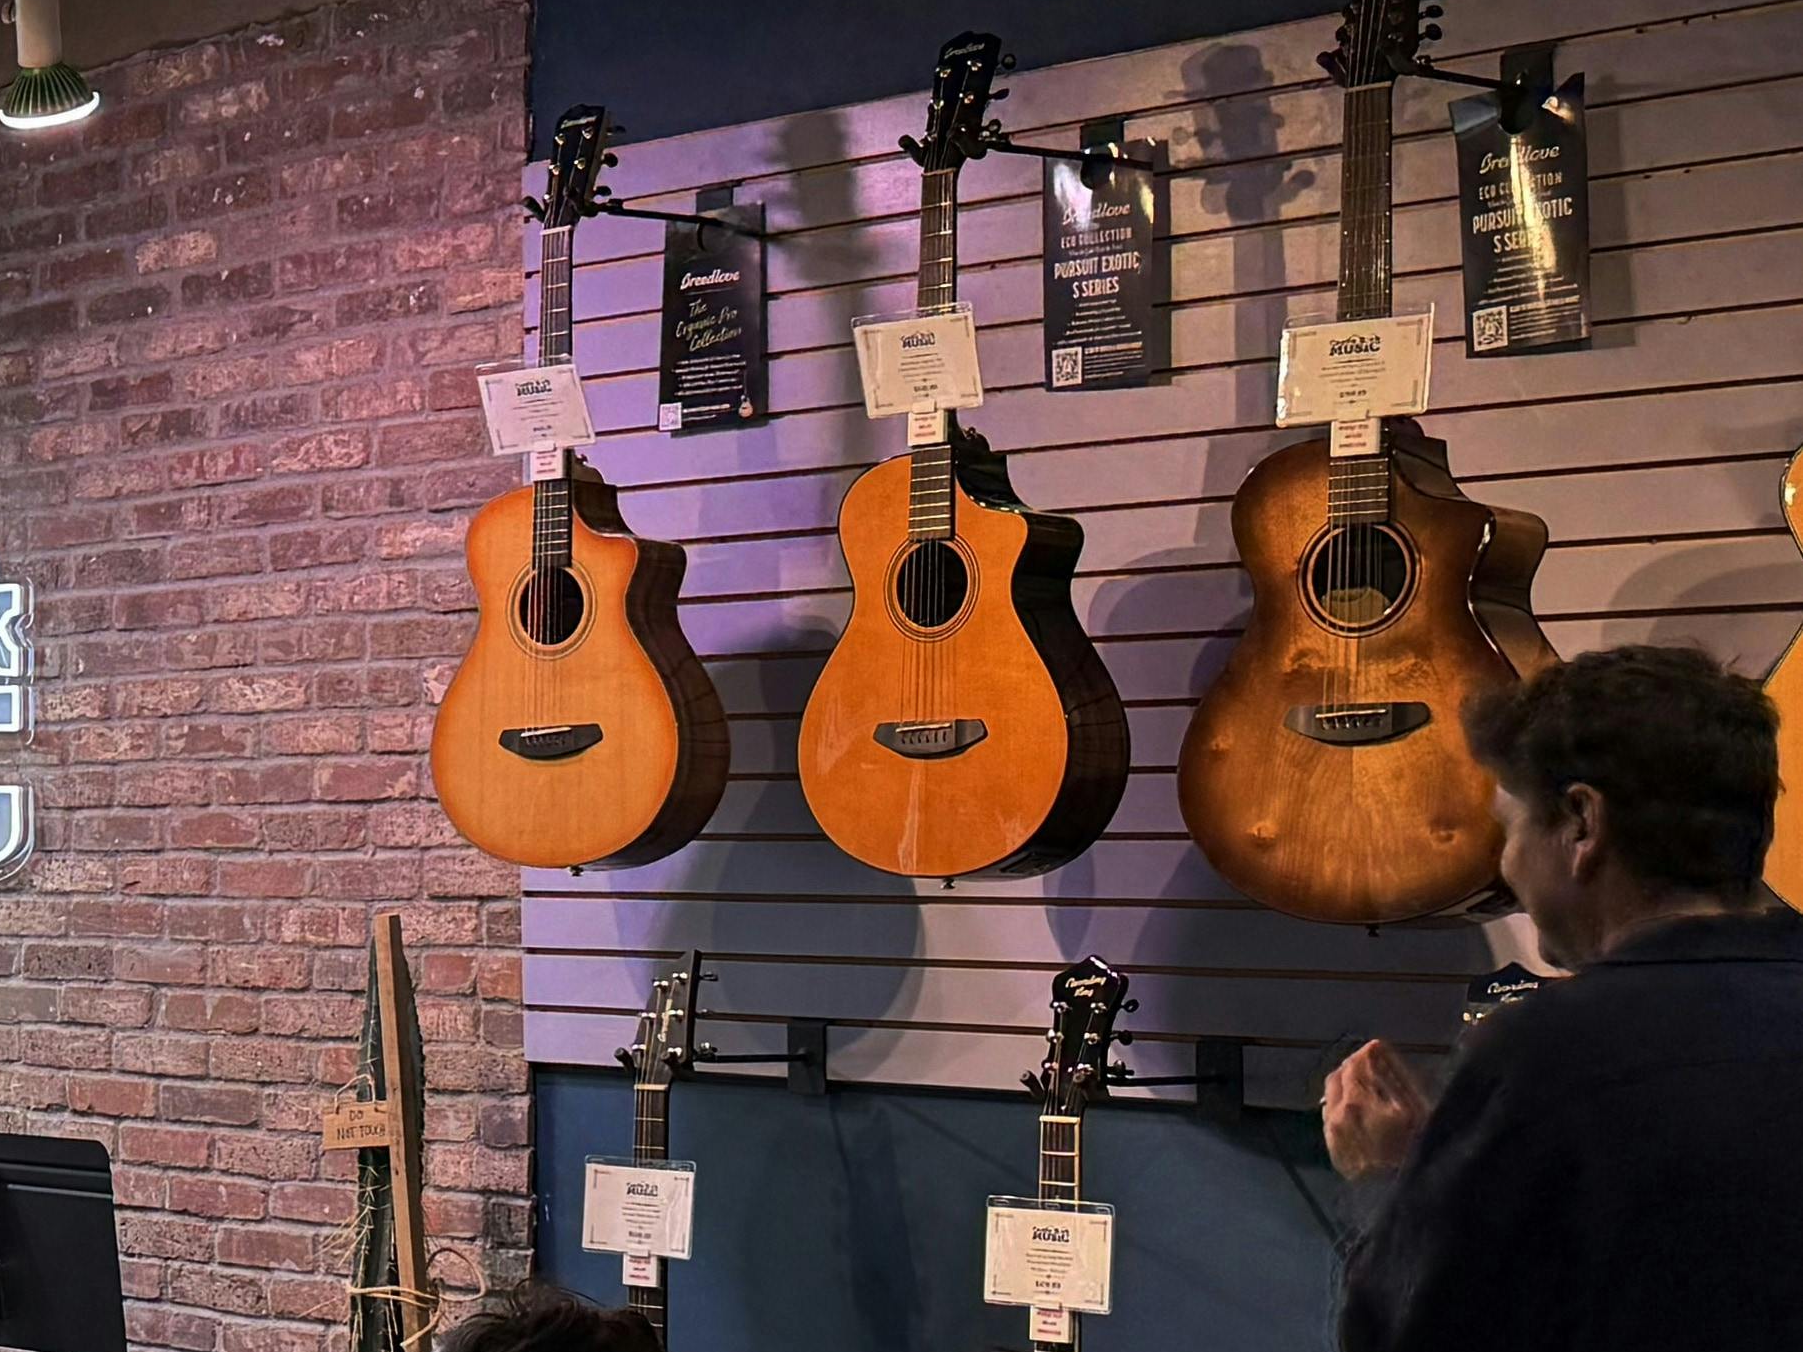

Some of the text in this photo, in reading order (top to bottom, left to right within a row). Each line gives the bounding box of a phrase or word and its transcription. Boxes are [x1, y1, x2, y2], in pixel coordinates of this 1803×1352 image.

[1472, 207, 1521, 235] PURSUI
[1527, 197, 1573, 226] OTIC
[1054, 251, 1142, 280] PURSUIT EXOTIC
[1073, 277, 1121, 299] S SERIES
